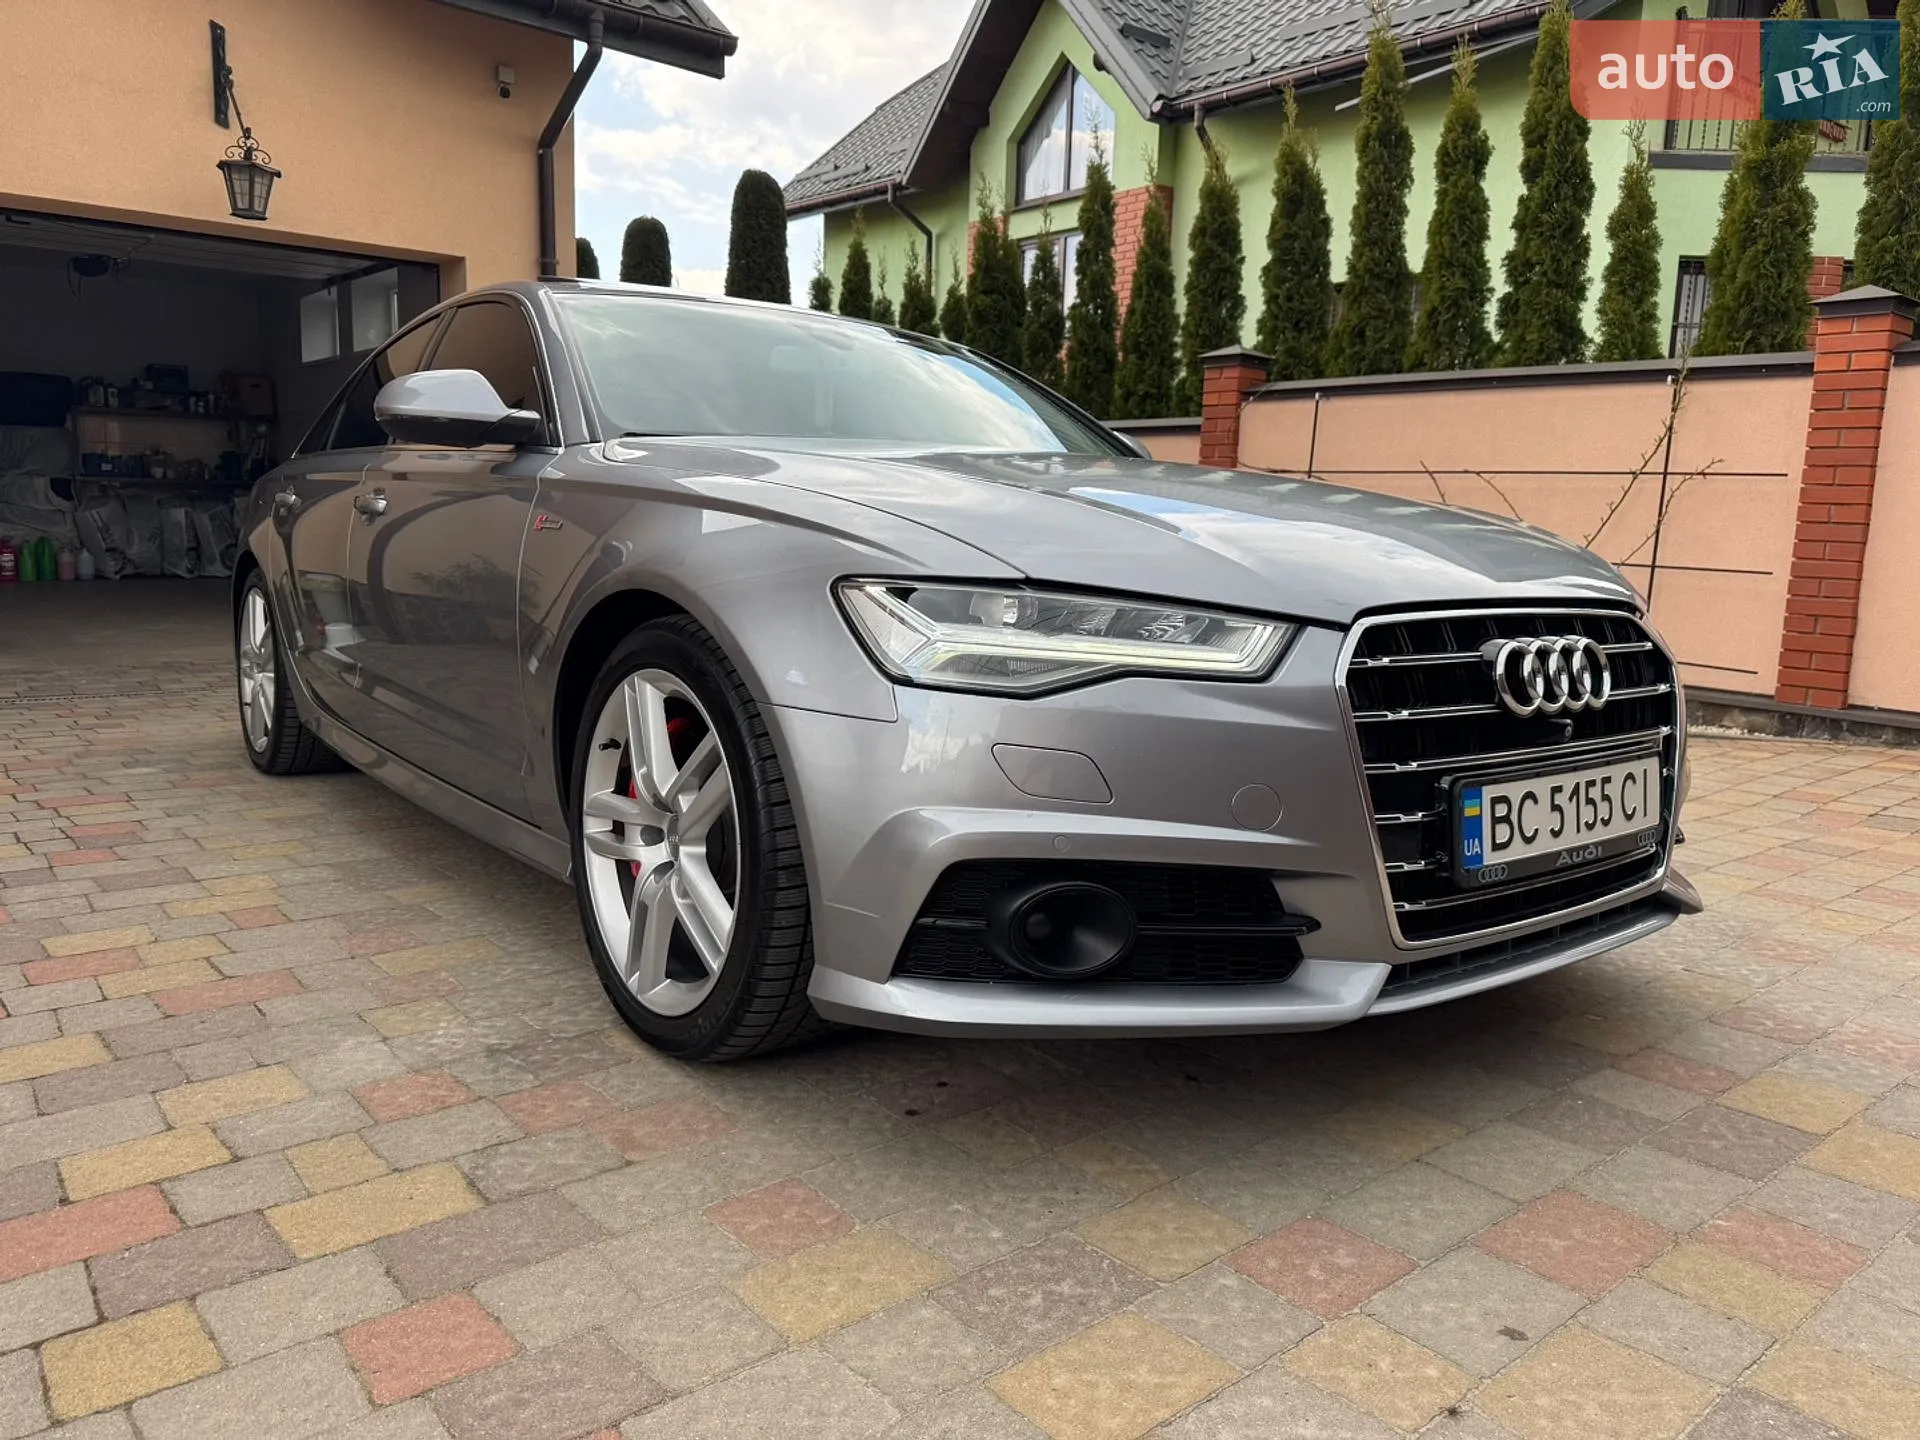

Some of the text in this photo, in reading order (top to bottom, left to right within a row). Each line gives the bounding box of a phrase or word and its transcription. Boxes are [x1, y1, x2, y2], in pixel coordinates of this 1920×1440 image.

[1490, 768, 1648, 852] BC 5155 CI
[1464, 839, 1481, 856] UA
[1556, 847, 1603, 866] Audi
